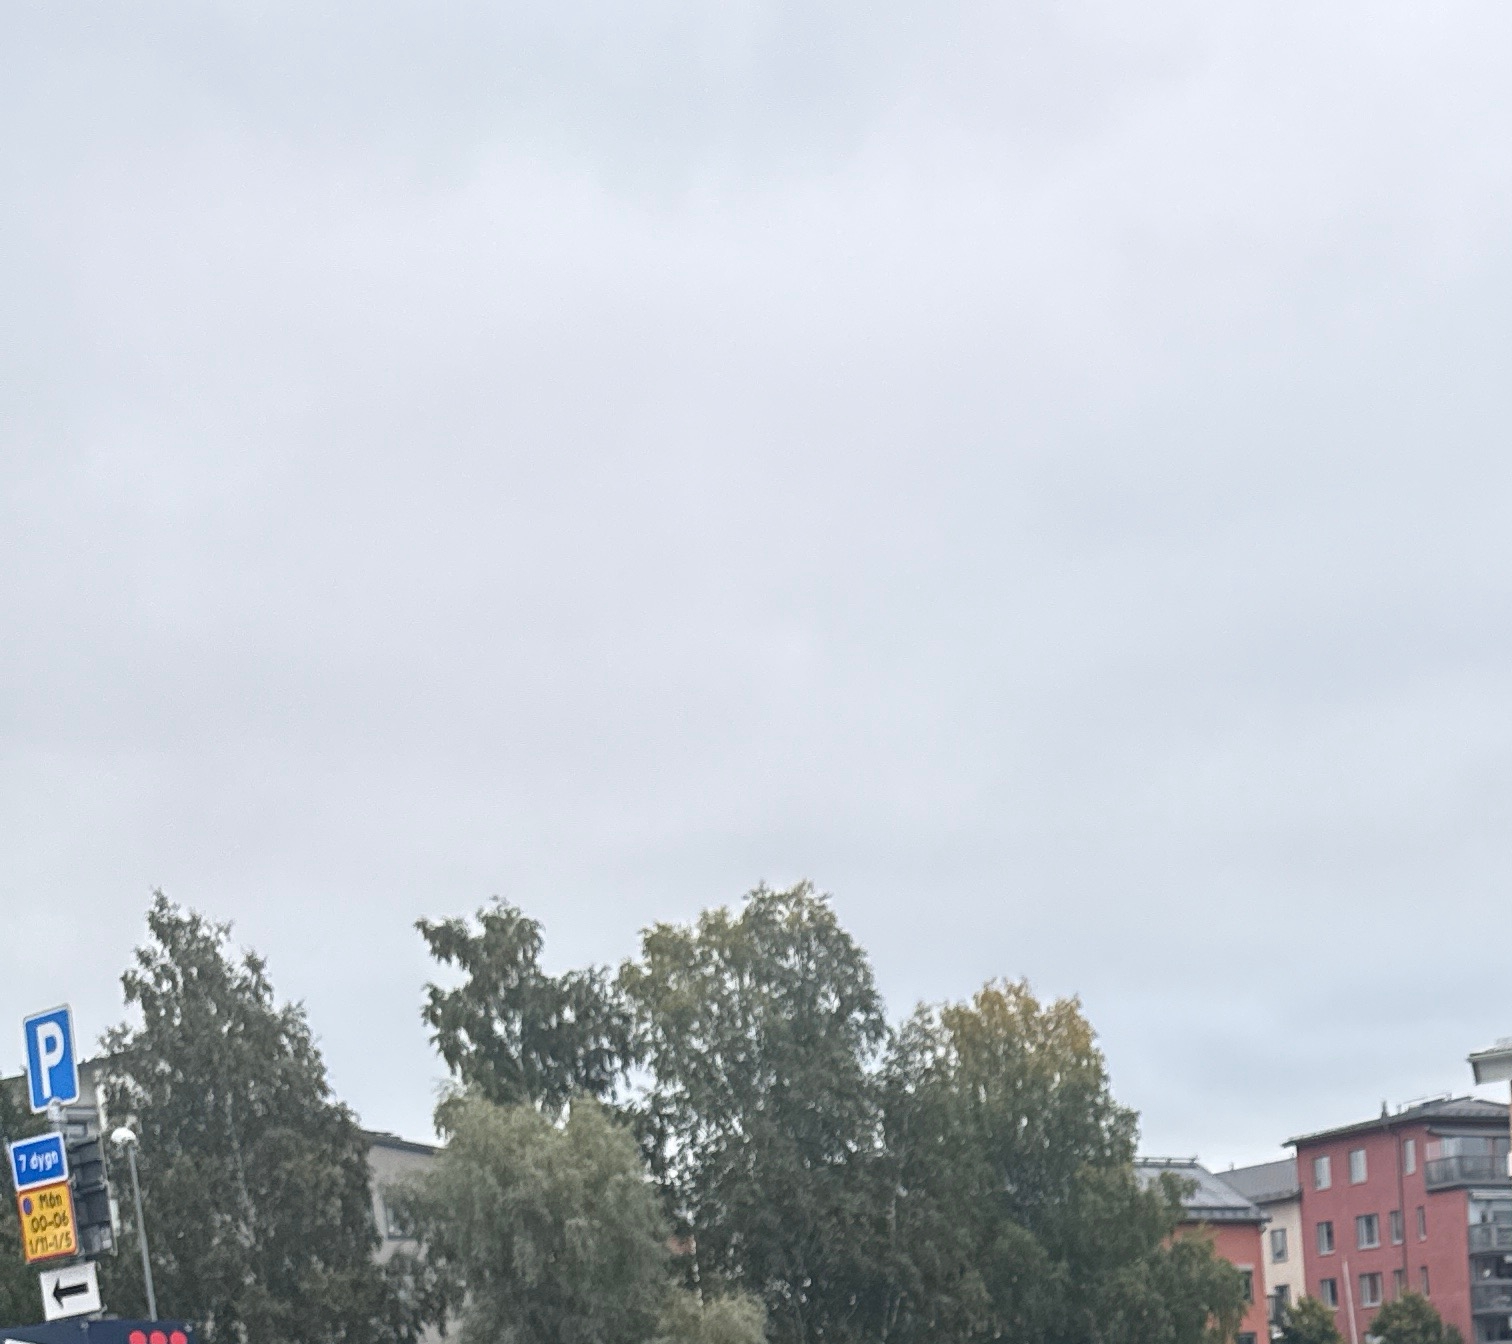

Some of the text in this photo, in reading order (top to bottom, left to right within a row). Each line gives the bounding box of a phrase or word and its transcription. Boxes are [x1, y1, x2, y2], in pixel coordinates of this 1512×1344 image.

[36, 1020, 65, 1098] P
[18, 1150, 59, 1173] 7 dygn
[31, 1210, 70, 1234] 00-06
